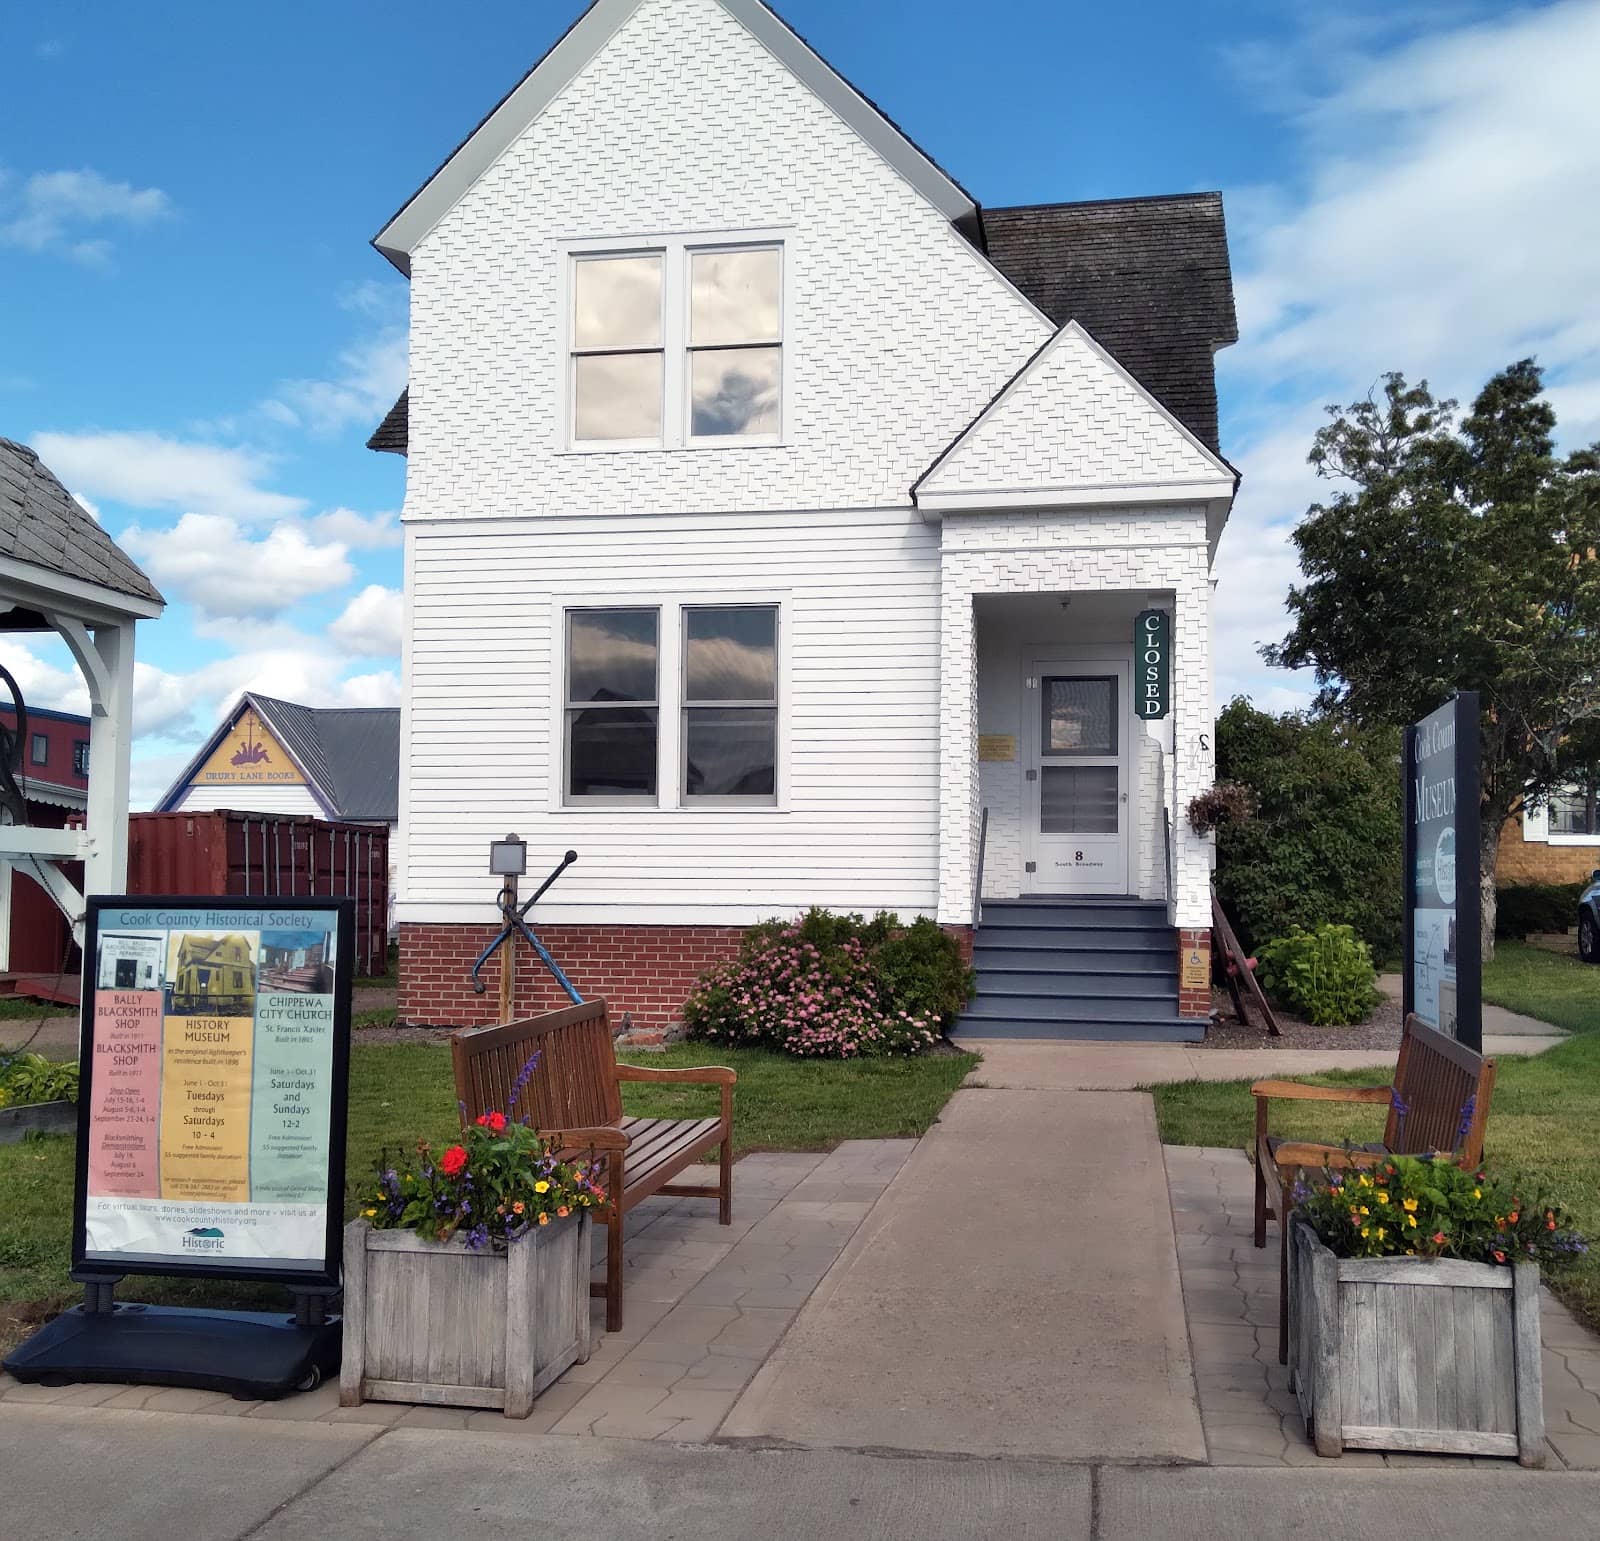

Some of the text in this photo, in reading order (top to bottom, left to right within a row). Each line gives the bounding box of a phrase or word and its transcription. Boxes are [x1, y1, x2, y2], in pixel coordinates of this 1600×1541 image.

[1144, 616, 1160, 714] CLOSED
[1075, 850, 1083, 861] 8
[120, 912, 313, 928] Cook County Historical Society
[114, 995, 142, 1005] BALLY
[269, 997, 323, 1008] CHIPPEWA
[98, 1006, 158, 1017] BLACKSMITH
[260, 1010, 332, 1020] CITY CHURCH
[114, 1018, 140, 1029] SHOP
[186, 1020, 230, 1030] HISTORY
[276, 1024, 301, 1032] Francis
[185, 1032, 230, 1042] MUSEUM
[96, 1043, 156, 1053] BLACKSMITH
[113, 1056, 138, 1066] SHOP
[271, 1079, 314, 1090] Saturdays
[186, 1090, 225, 1102] Tuesdays
[284, 1092, 300, 1102] and
[273, 1104, 310, 1116] Sundays
[184, 1115, 225, 1126] Saturdays
[282, 1120, 300, 1128] 12-2
[210, 1132, 215, 1140] 4
[112, 1202, 136, 1210] virtual
[189, 1206, 232, 1215] slideshows
[279, 1208, 296, 1216] visit
